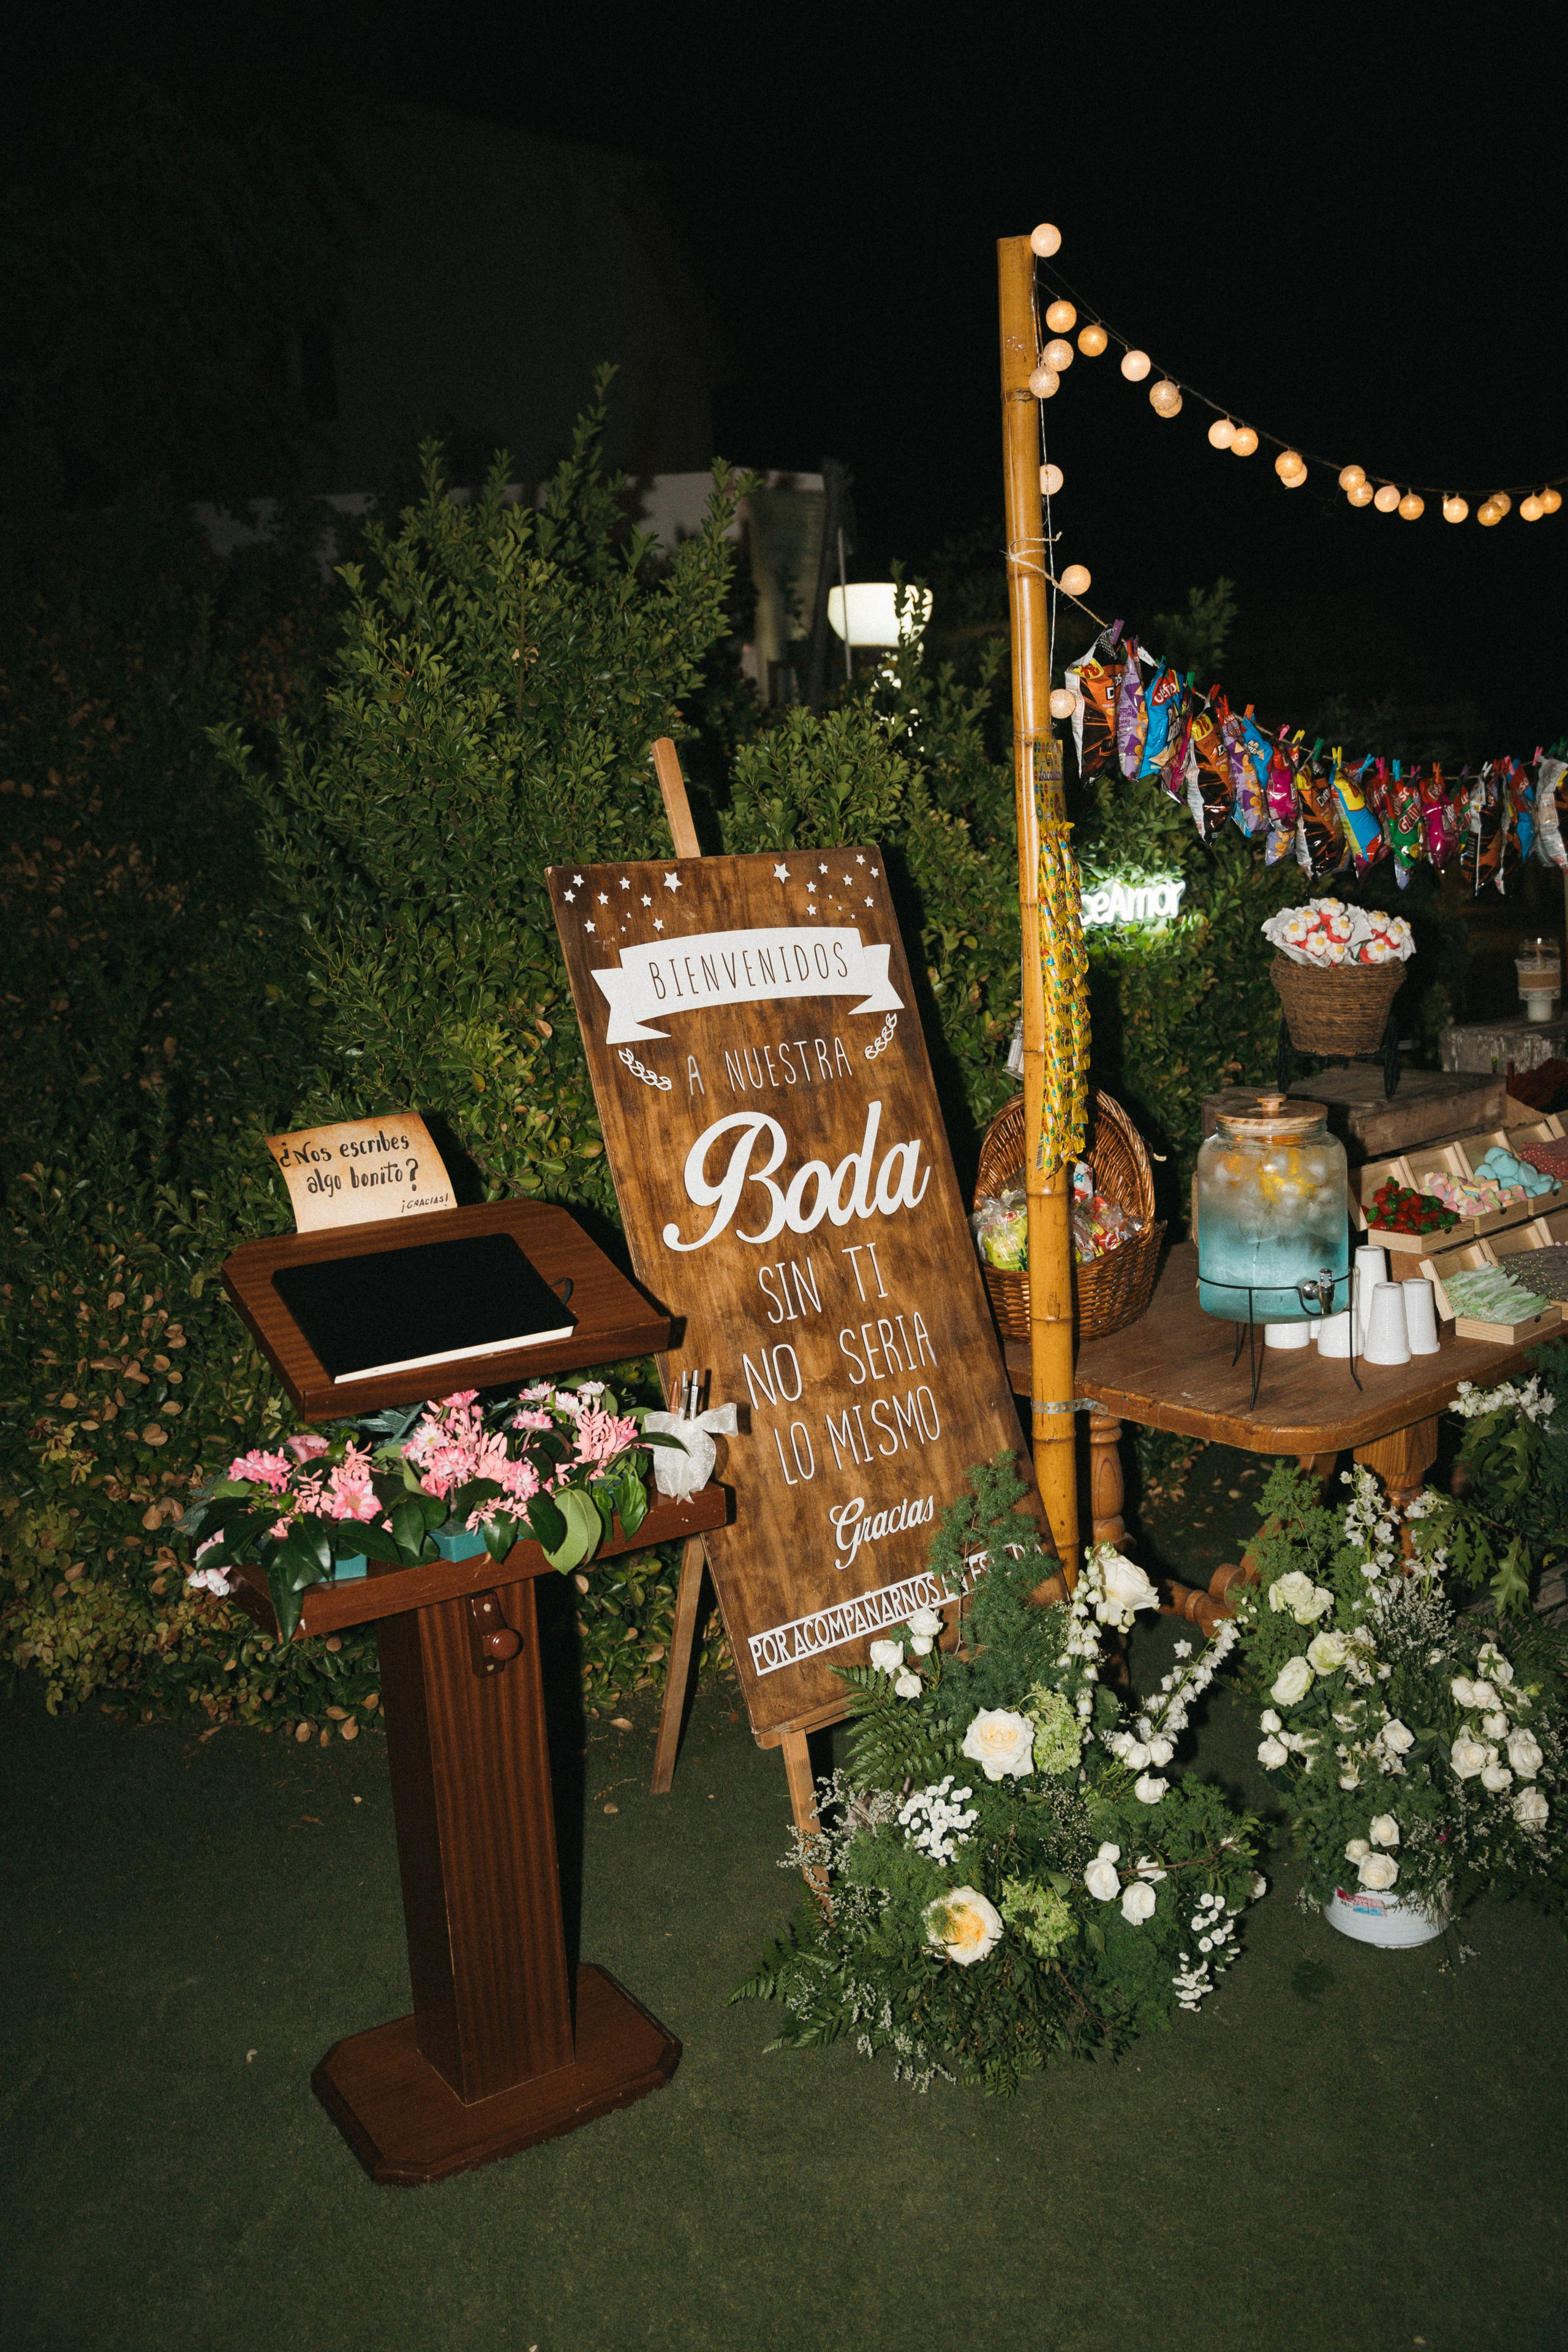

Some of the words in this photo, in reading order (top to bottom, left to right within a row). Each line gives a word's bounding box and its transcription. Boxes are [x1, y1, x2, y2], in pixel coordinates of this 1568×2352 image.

[649, 941, 850, 1000] BIENVENIDOS
[687, 1054, 706, 1096] A
[726, 1036, 853, 1092] NUESTRA
[279, 1141, 332, 1167] ¿Nos
[339, 1130, 409, 1158] escribes
[306, 1167, 342, 1198] algo
[350, 1158, 419, 1192] bonito?
[662, 1100, 932, 1253] Boda
[401, 1193, 449, 1213] ¡GRACIAS!
[758, 1257, 823, 1324] SIN
[841, 1242, 889, 1302] TI
[741, 1343, 803, 1410] NO
[839, 1311, 938, 1385] SERIA
[773, 1421, 815, 1485] LO
[824, 1385, 941, 1471] MISMO
[829, 1494, 934, 1570] Gracias
[748, 1628, 792, 1673] POR
[794, 1574, 941, 1657] ACOMPAÑARNOS
